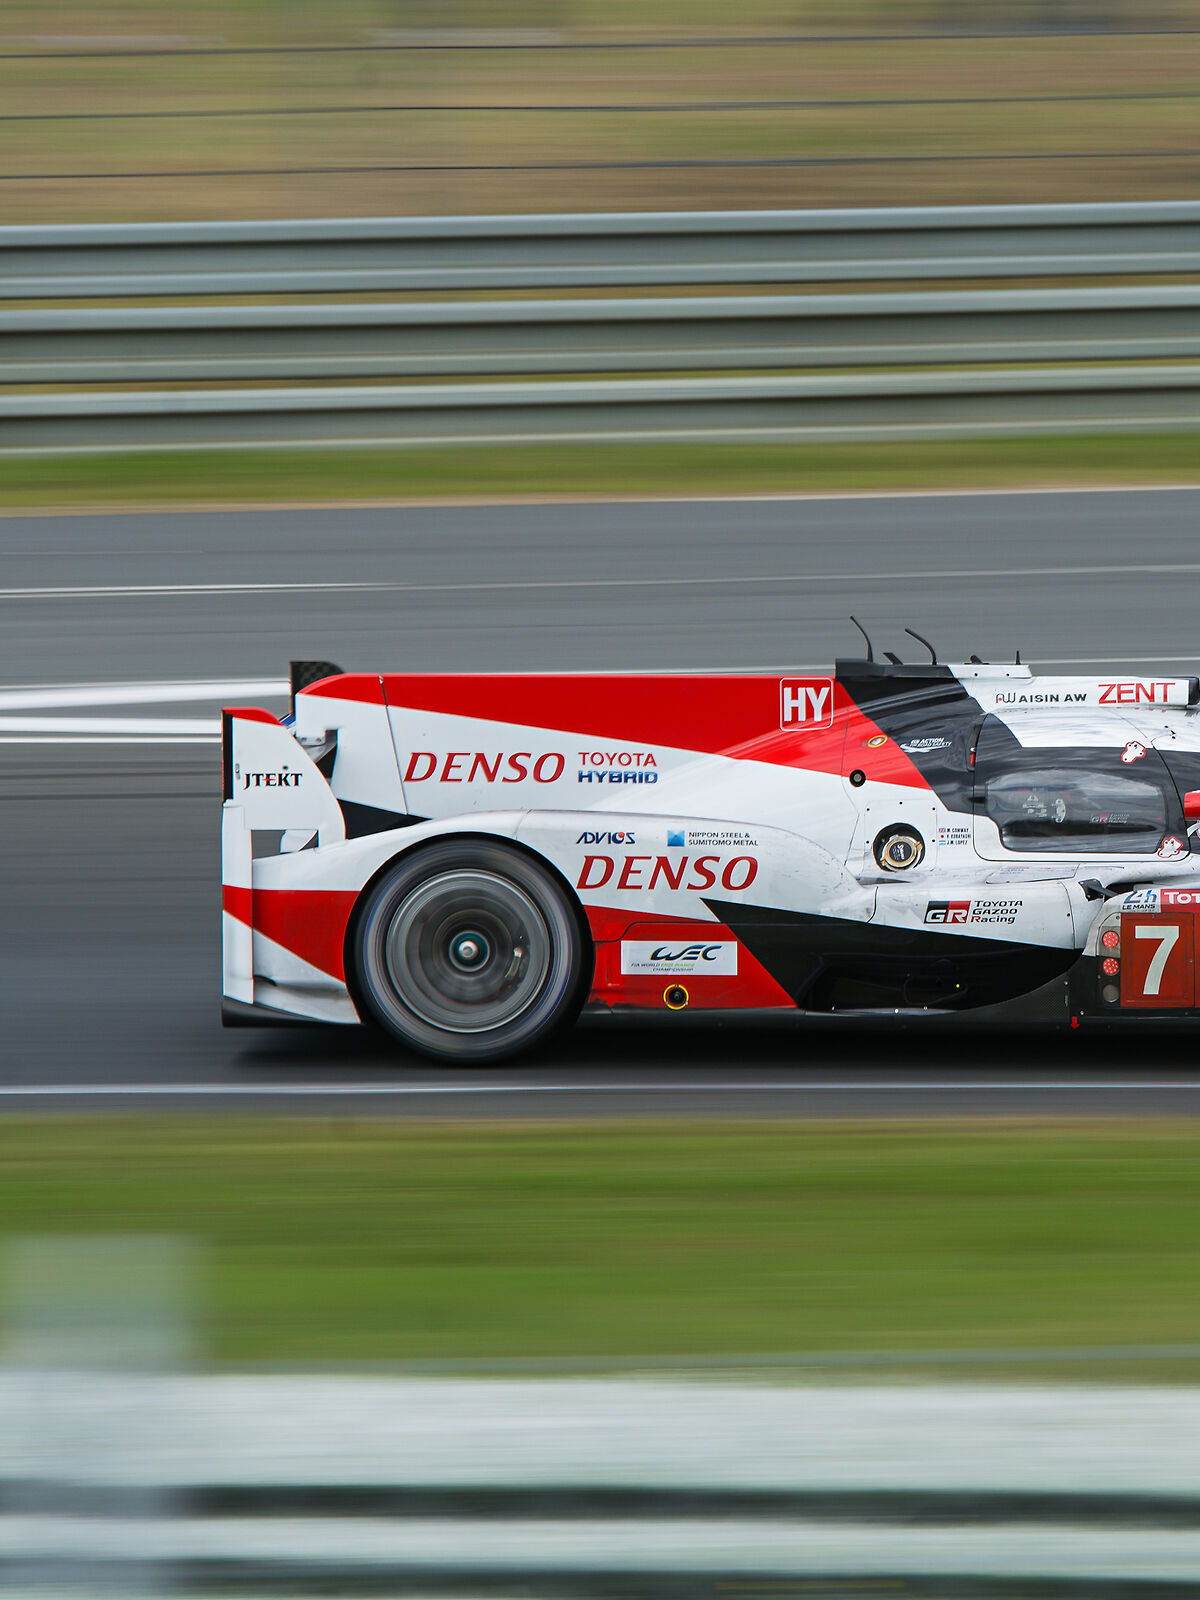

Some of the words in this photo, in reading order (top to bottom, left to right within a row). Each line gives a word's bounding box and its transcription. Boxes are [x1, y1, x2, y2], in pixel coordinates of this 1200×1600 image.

[1018, 693, 1059, 703] AISIN
[1063, 693, 1087, 702] AW
[1098, 682, 1176, 704] ZENT
[782, 687, 830, 722] HY
[403, 752, 565, 783] DENSO
[578, 752, 657, 767] TOYOTA
[243, 773, 303, 790] JTEKT
[578, 771, 658, 784] HYBRID
[576, 831, 636, 845] ADVICS
[576, 855, 759, 891] DENSO
[925, 909, 968, 923] GR
[970, 916, 1016, 924] Racing
[649, 944, 723, 961] WEC
[1134, 925, 1180, 995] 7
